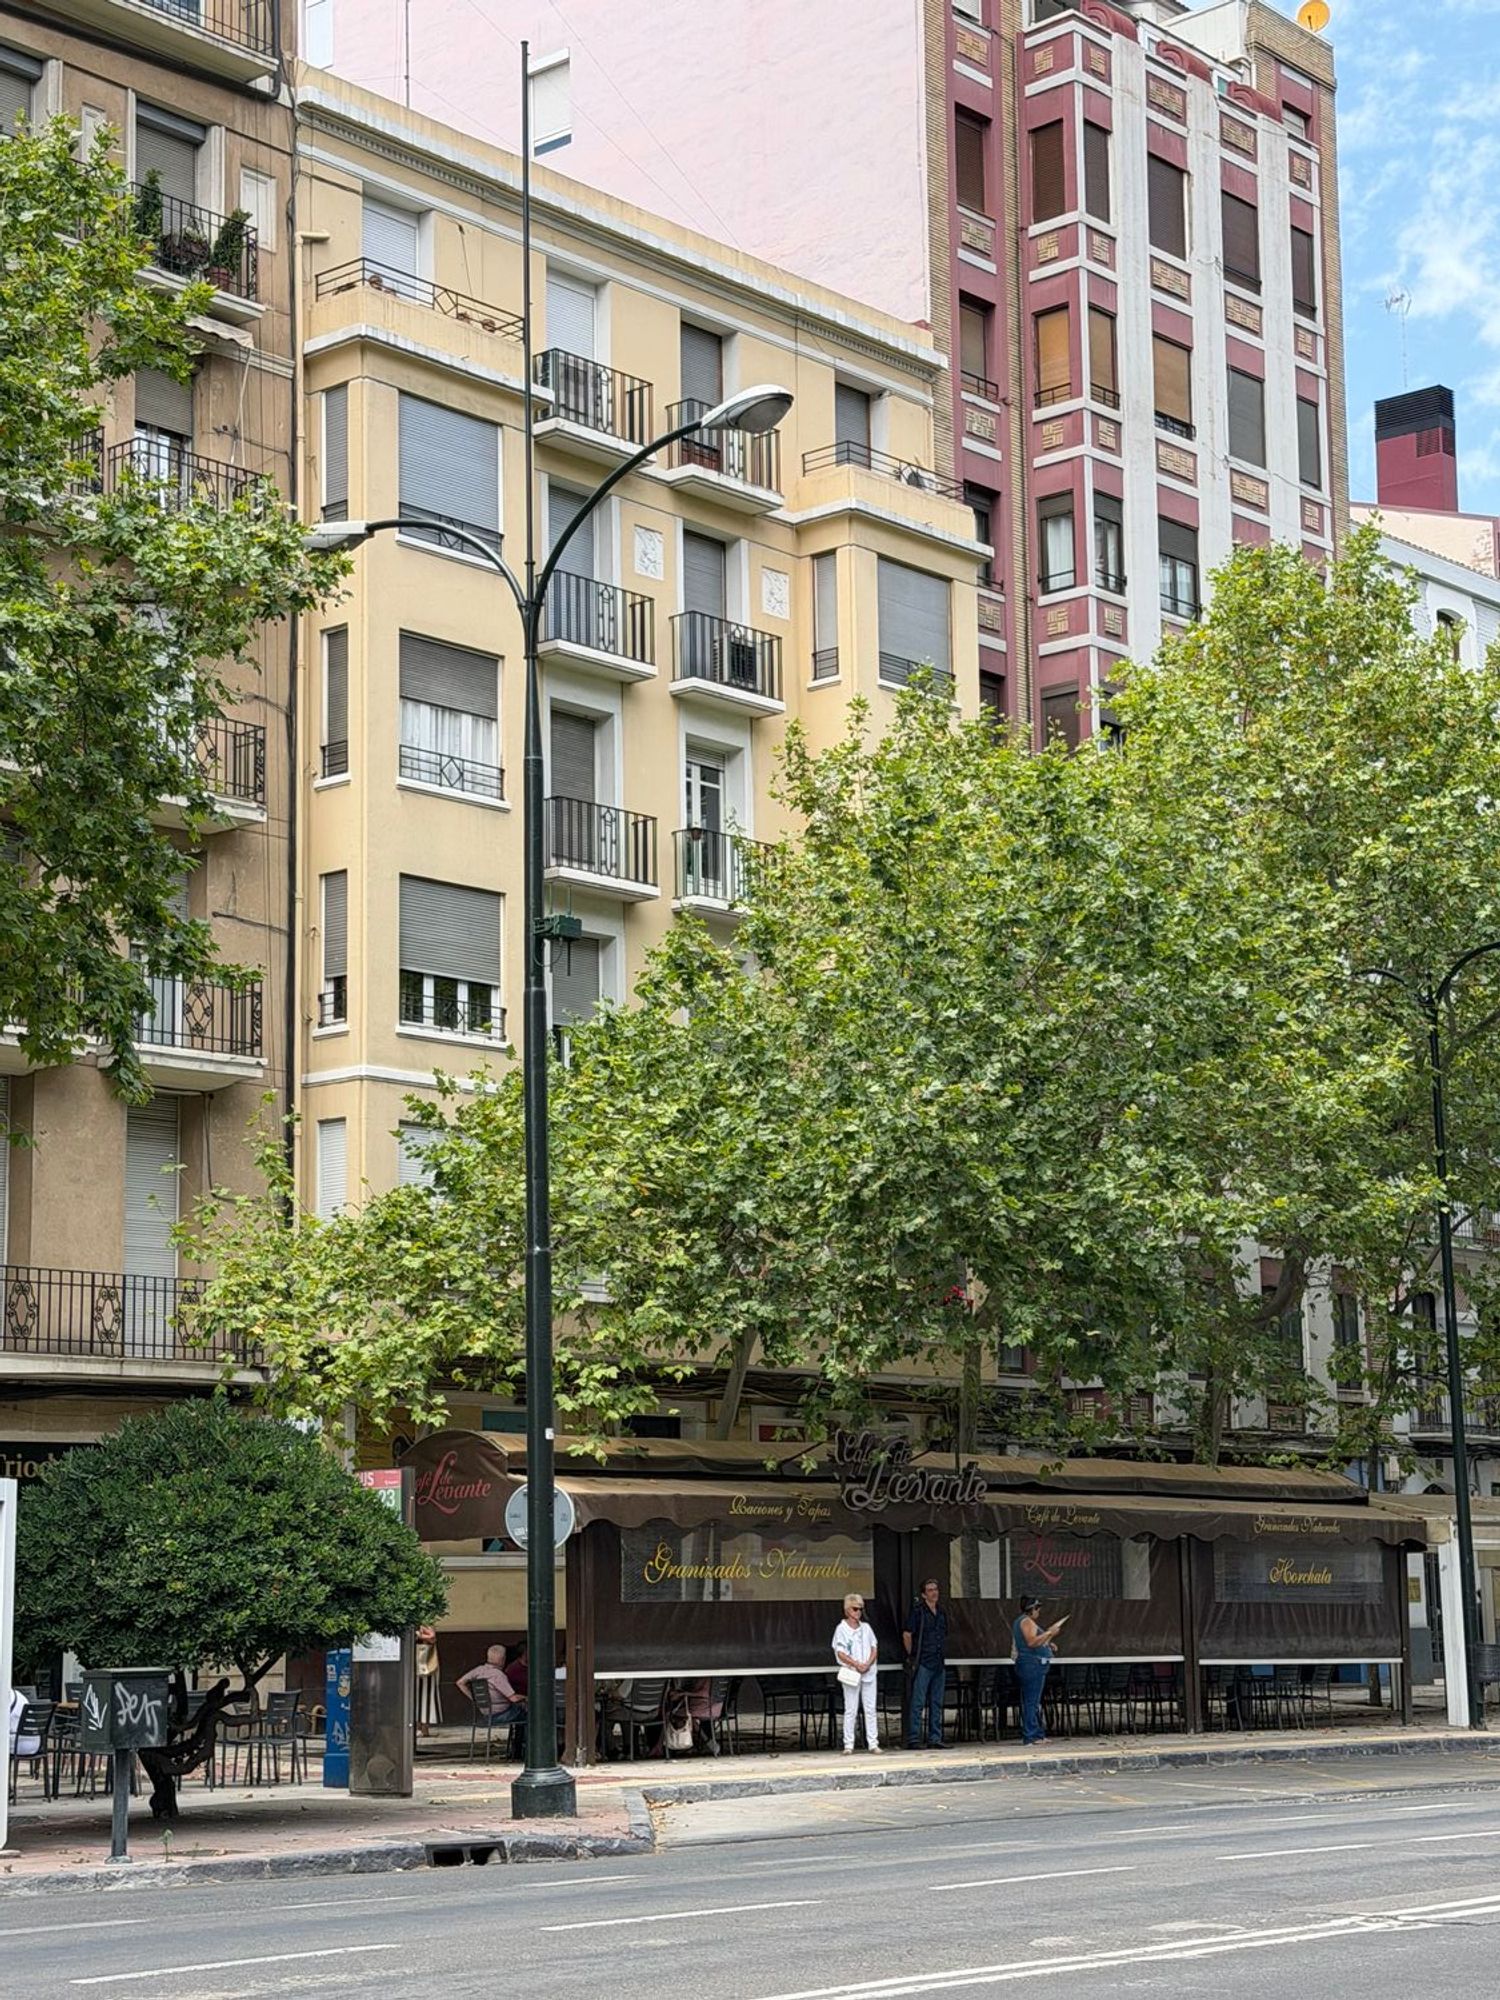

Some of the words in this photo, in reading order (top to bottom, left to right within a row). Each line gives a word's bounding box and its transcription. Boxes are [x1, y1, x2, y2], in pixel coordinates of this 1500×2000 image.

[359, 1471, 375, 1487] US
[417, 1450, 492, 1515] Levante
[842, 1435, 988, 1511] Levante
[728, 1494, 783, 1516] Raciones
[784, 1505, 794, 1523] y
[797, 1495, 832, 1522] Tapas
[644, 1541, 751, 1584] Granizados
[759, 1547, 850, 1579] Naturales
[1269, 1557, 1333, 1585] Horchata
